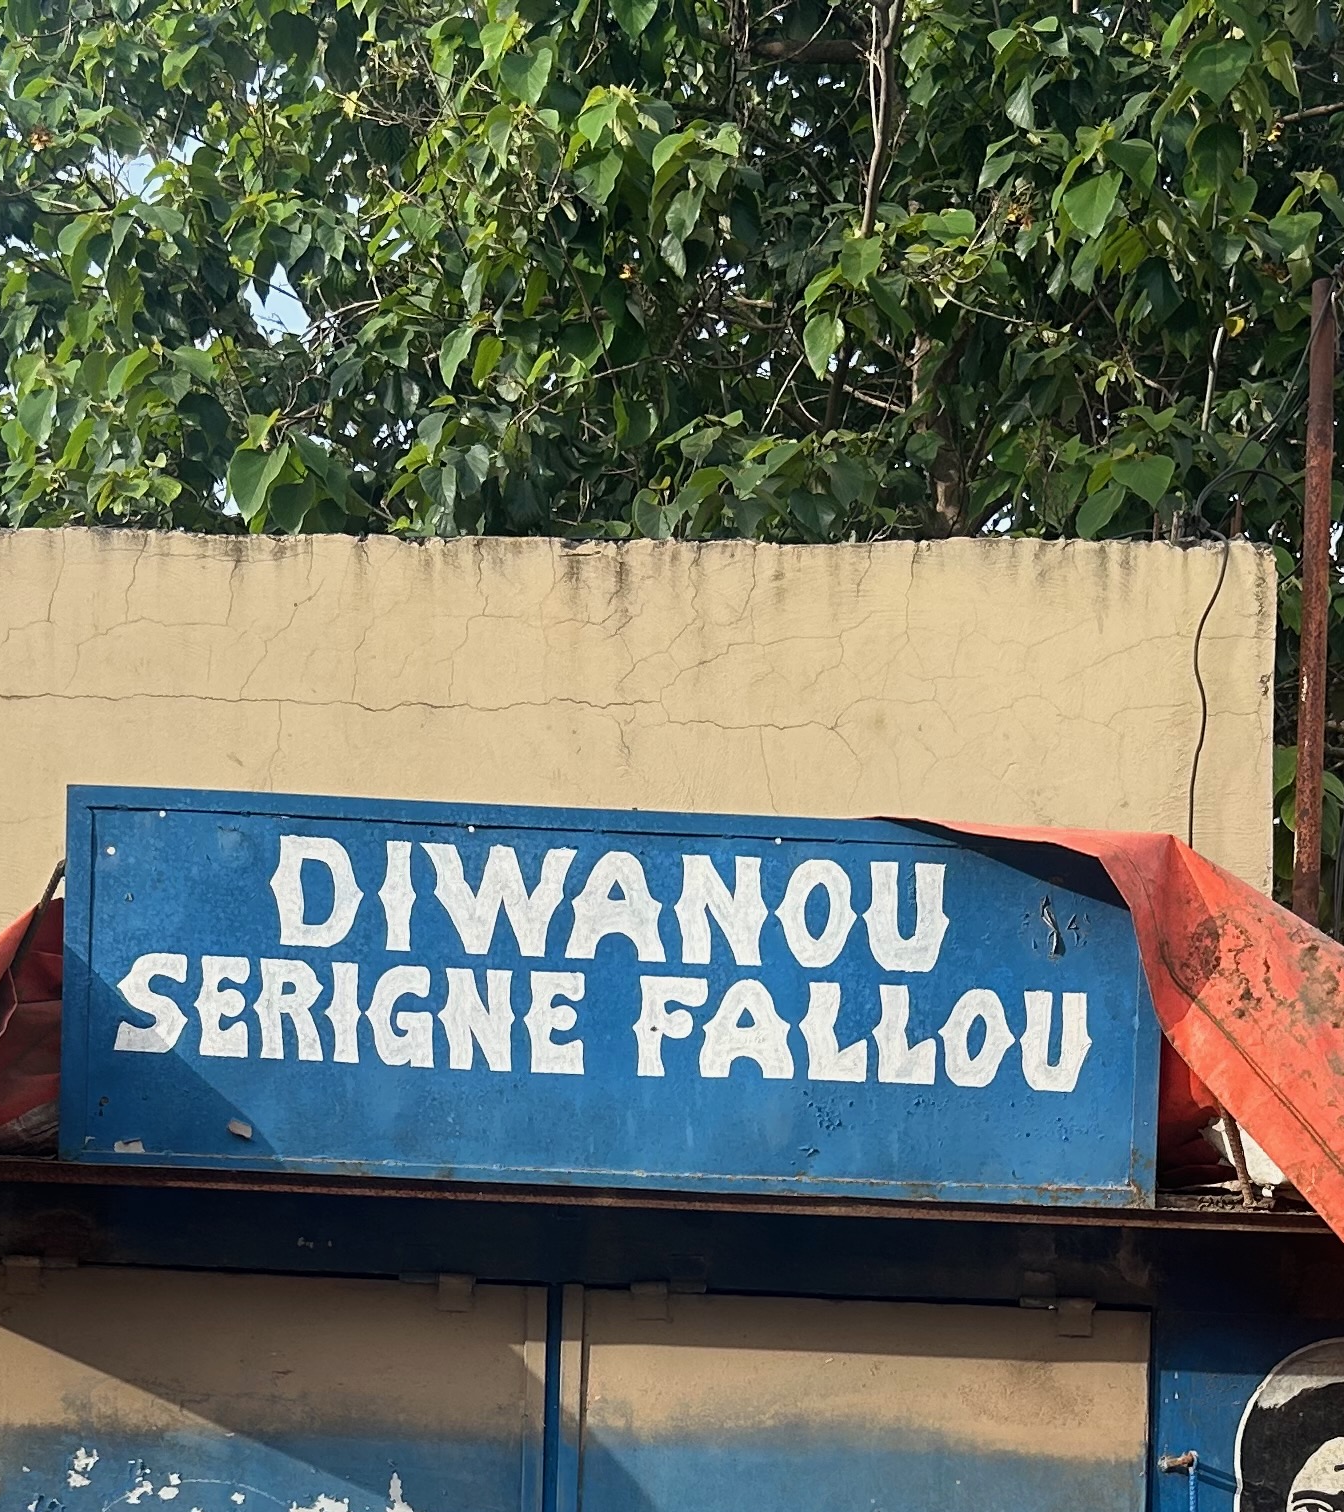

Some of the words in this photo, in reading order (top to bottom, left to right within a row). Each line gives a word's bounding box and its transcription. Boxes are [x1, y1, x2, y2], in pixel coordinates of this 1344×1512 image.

[269, 834, 950, 974] DIWANOU
[111, 952, 586, 1076] SERIGNE
[631, 975, 1093, 1093] FALLOU
